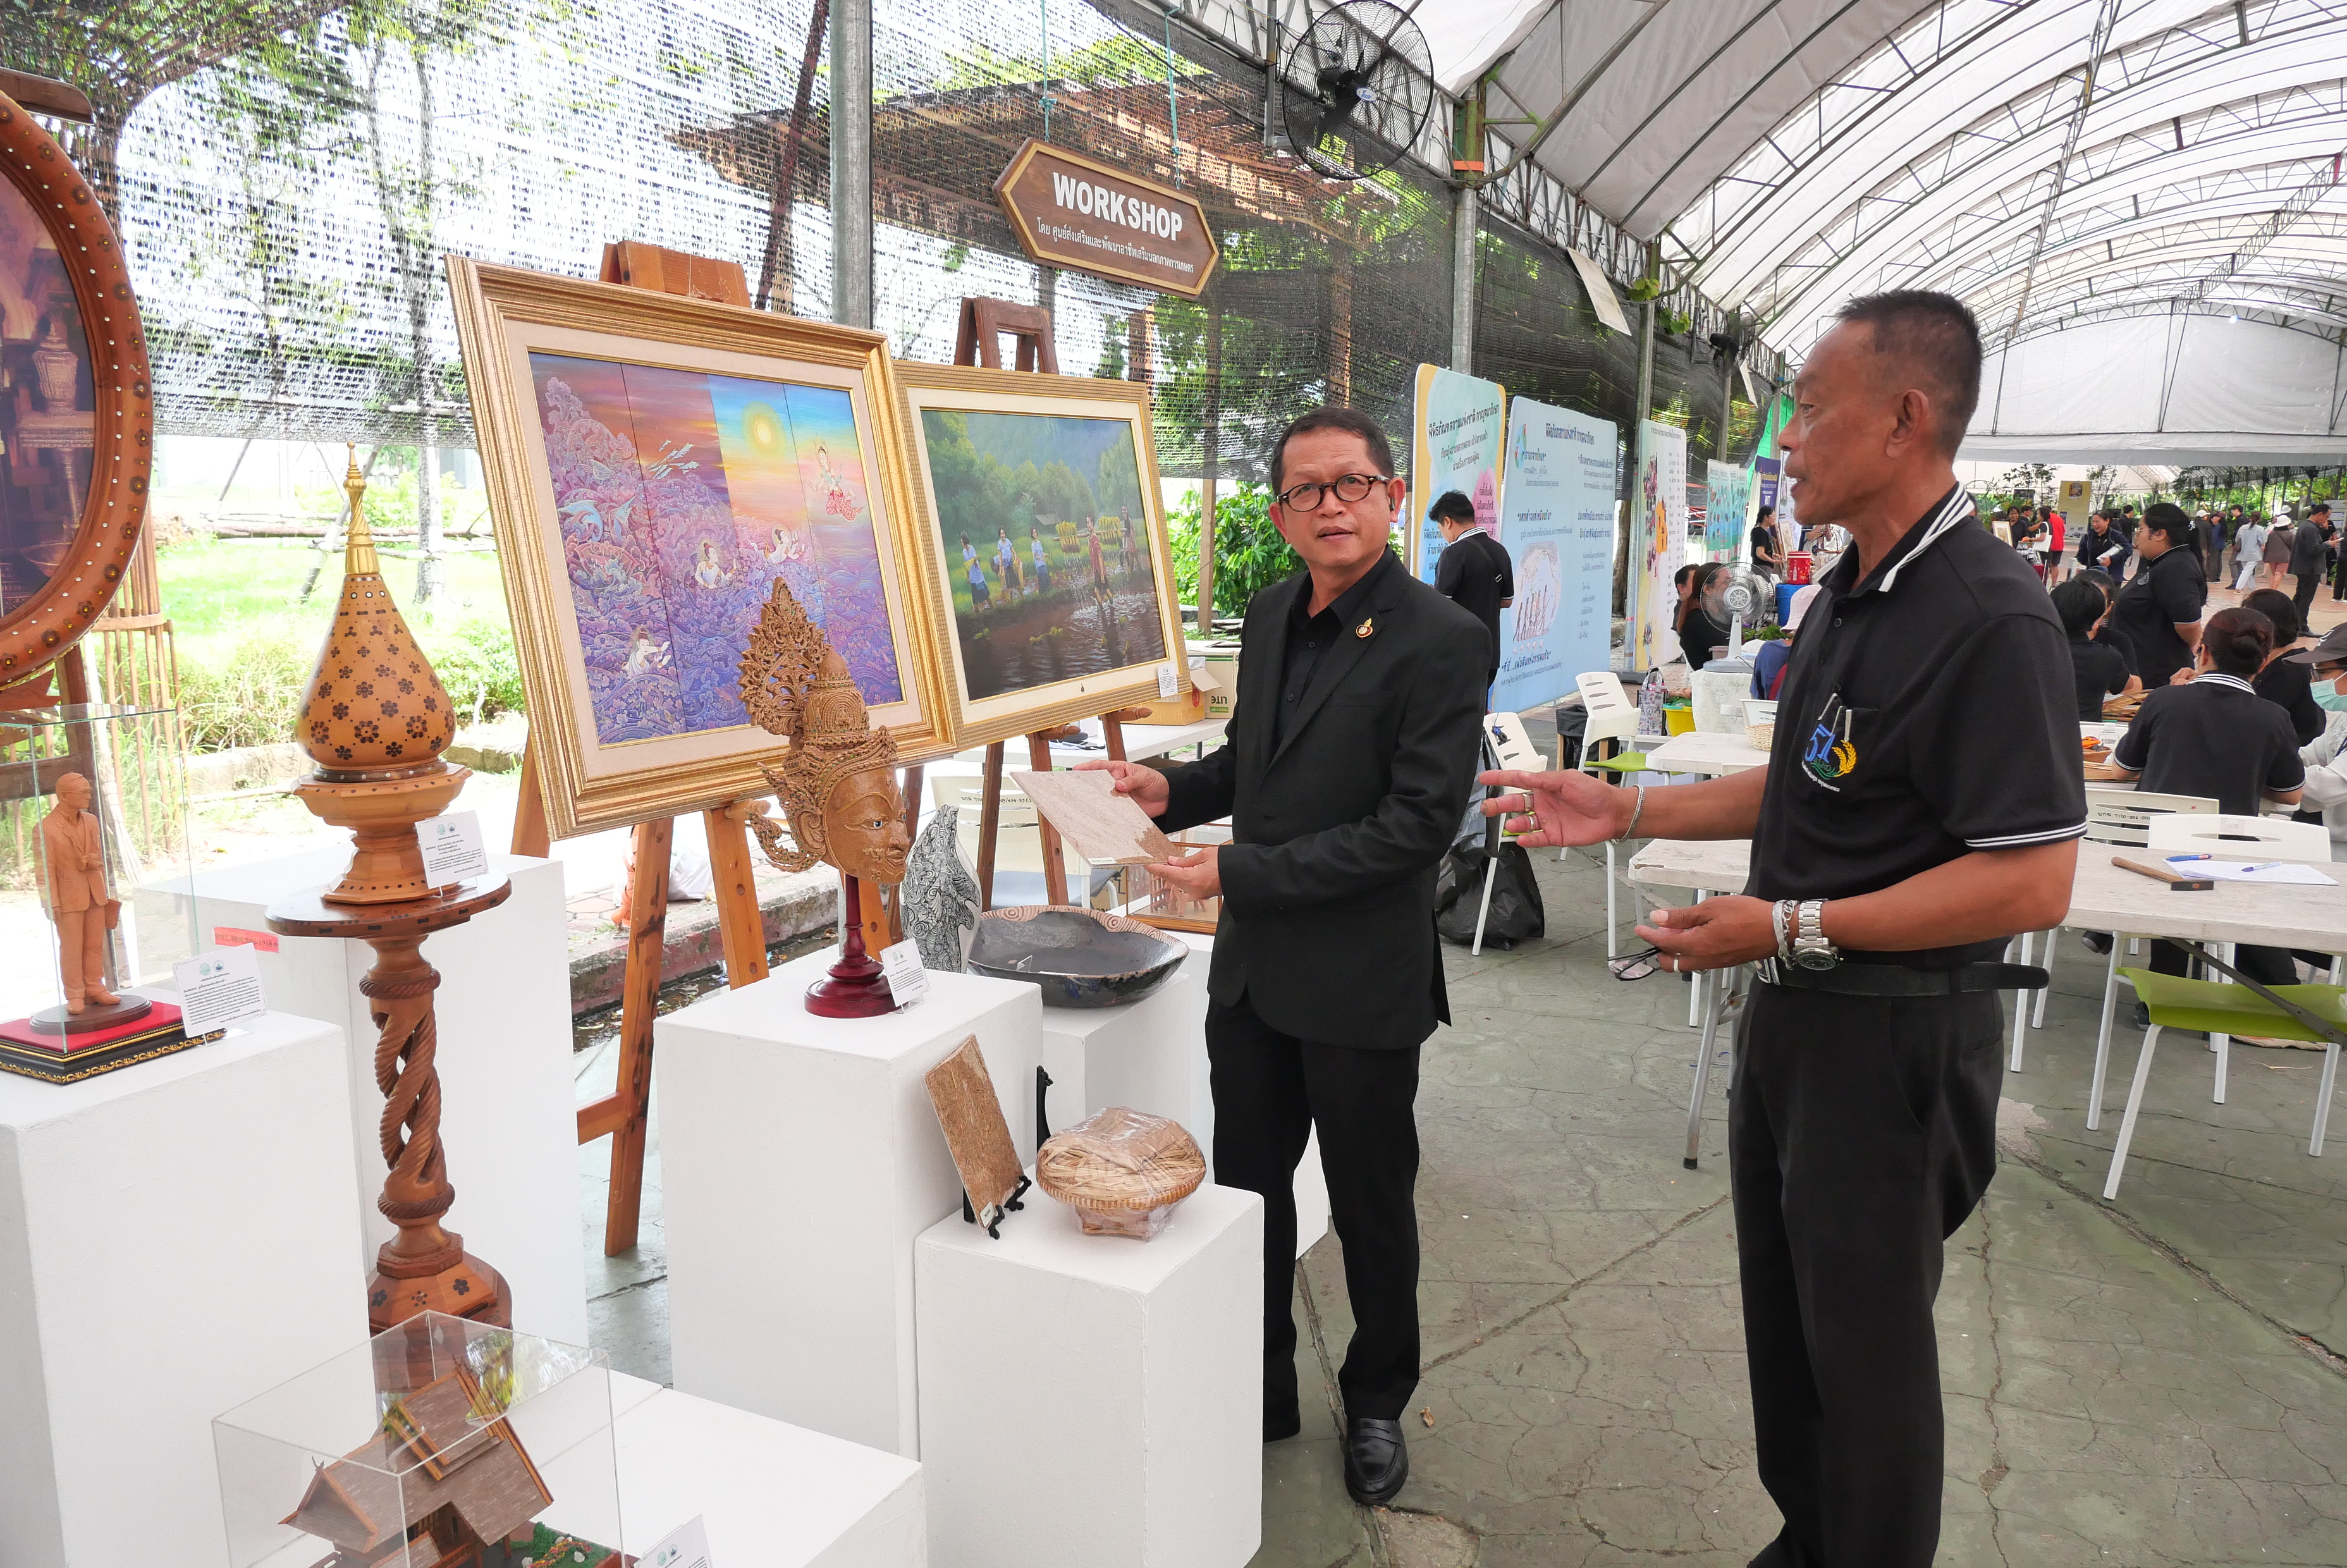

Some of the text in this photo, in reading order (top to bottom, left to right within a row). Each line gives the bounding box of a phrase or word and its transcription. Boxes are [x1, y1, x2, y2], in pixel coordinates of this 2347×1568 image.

[1053, 171, 1182, 242] WORKSHOP
[1037, 216, 1050, 235] โดย
[1211, 695, 1227, 704] LITE
